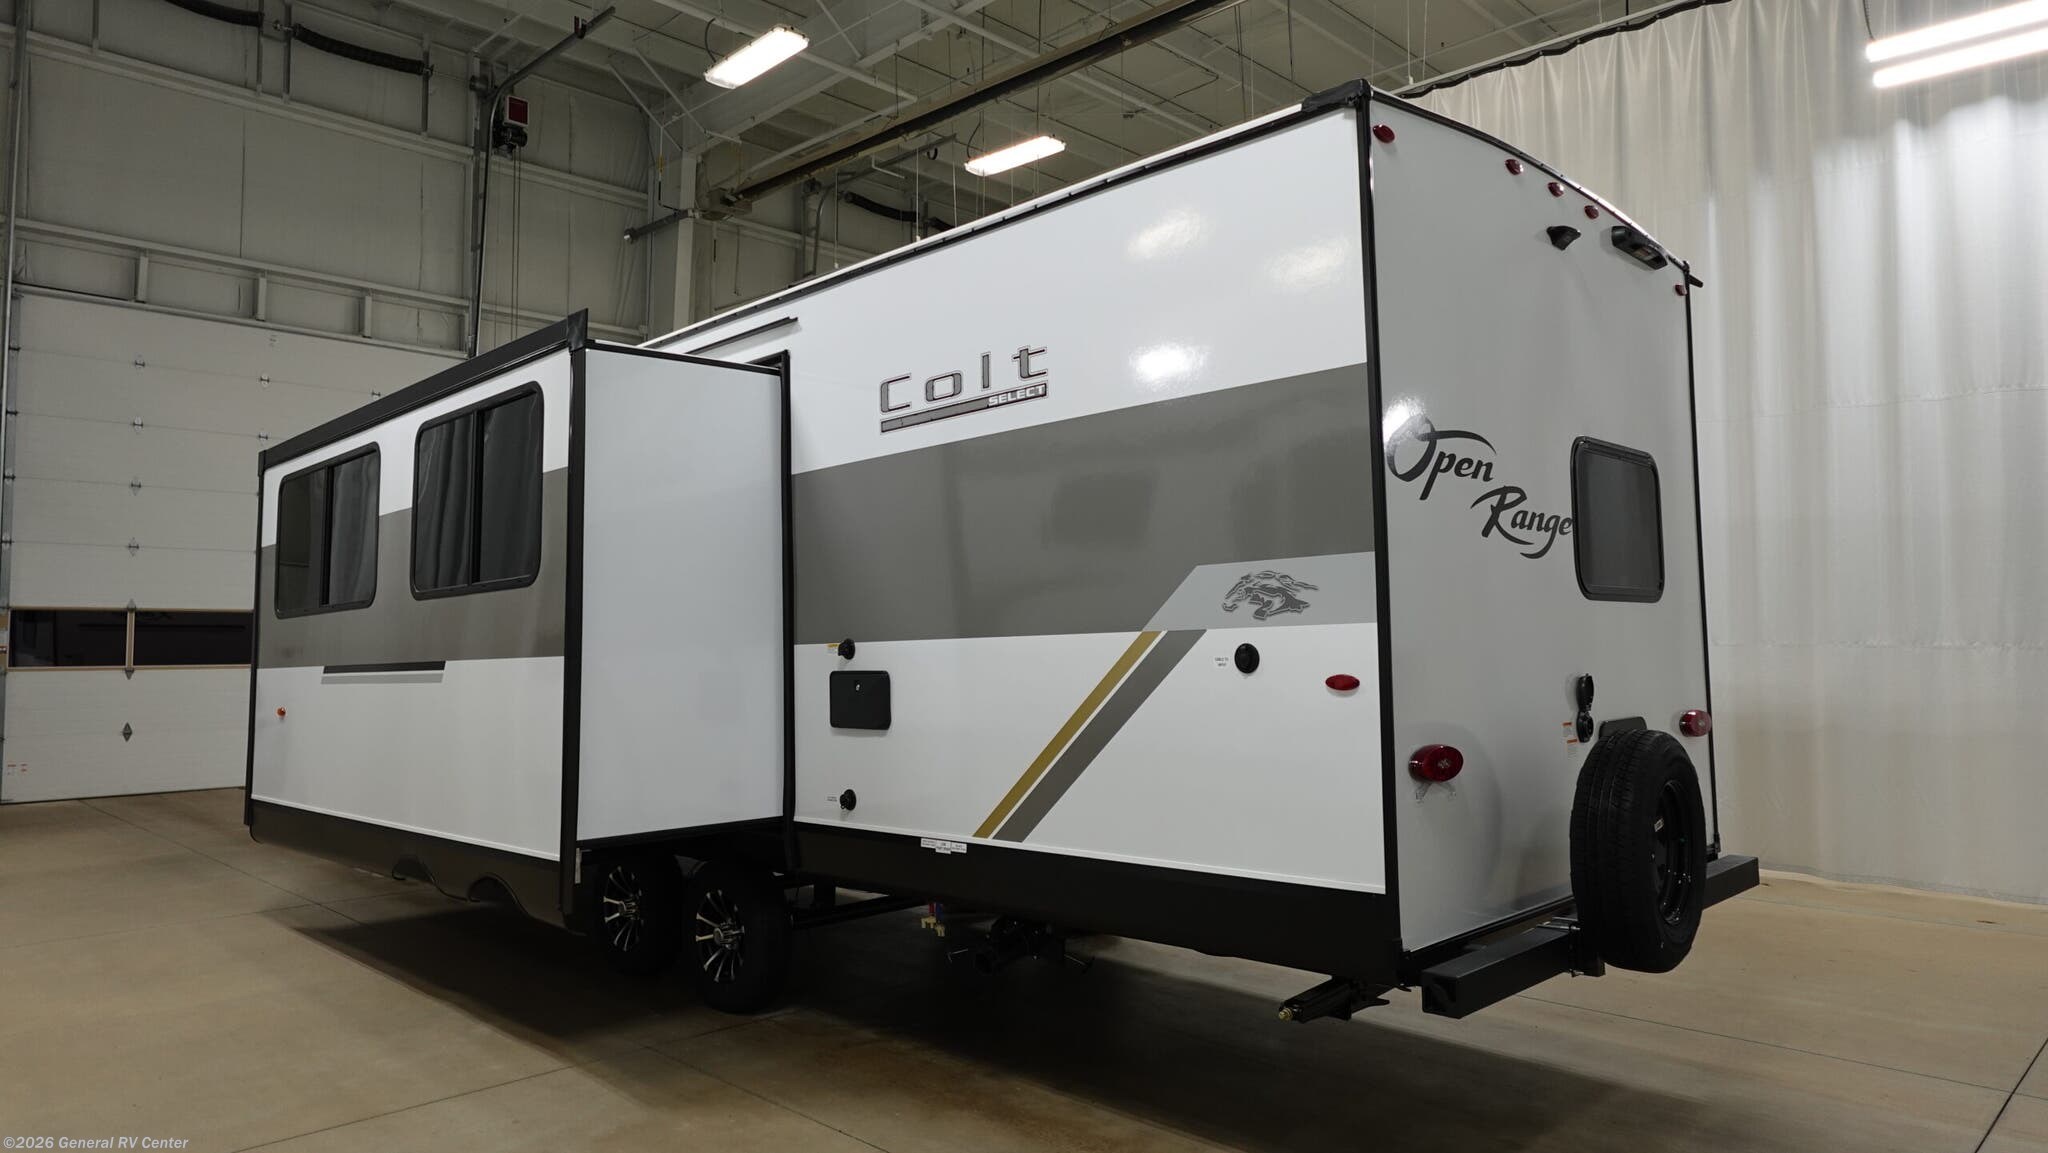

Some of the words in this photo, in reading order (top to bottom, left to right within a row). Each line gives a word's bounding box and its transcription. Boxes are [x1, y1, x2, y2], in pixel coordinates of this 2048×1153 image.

[880, 348, 1047, 413] Colt
[988, 384, 1045, 407] SELECT
[1387, 413, 1497, 500] Open
[1470, 485, 1574, 559] Range
